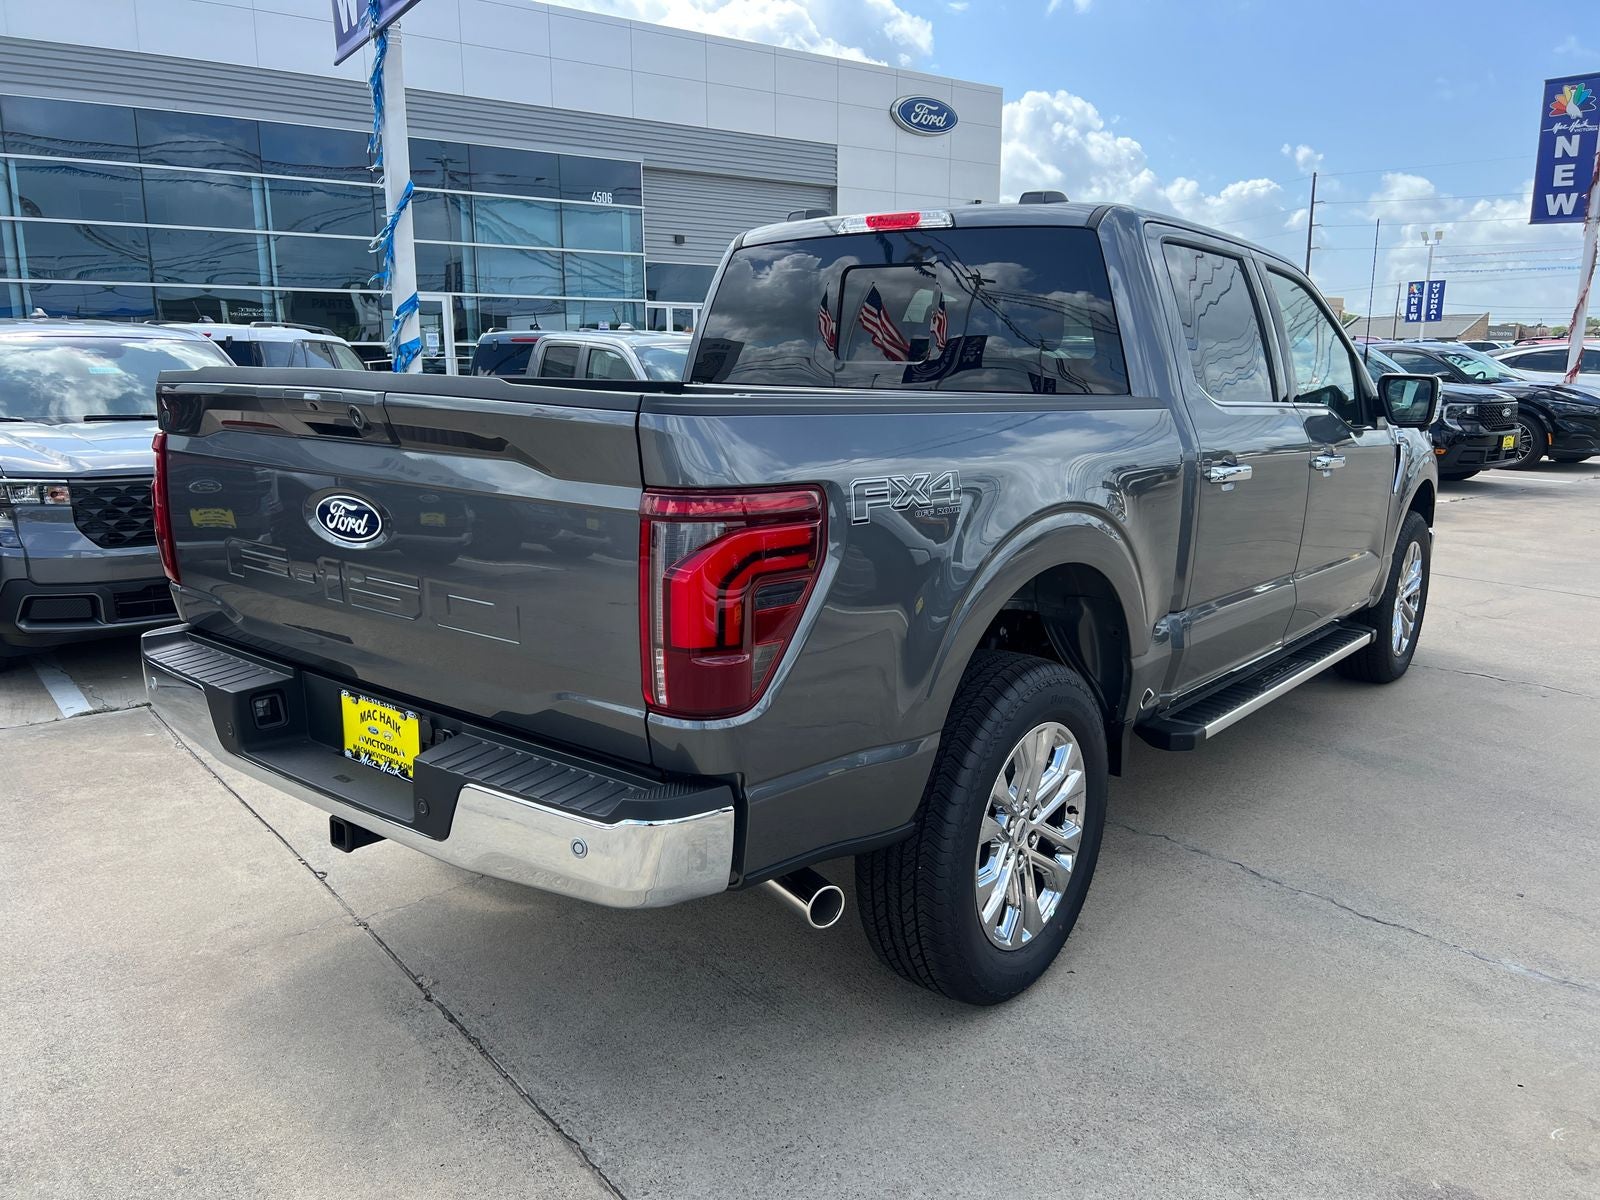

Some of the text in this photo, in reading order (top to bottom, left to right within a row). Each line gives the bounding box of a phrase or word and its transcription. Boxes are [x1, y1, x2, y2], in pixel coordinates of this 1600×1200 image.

[910, 102, 948, 127] Ford
[1545, 135, 1580, 216] NEW
[591, 191, 613, 204] 4506
[1408, 298, 1418, 321] NEW
[1430, 283, 1440, 320] HYUNDAI
[849, 469, 962, 526] FX4
[326, 500, 369, 535] Ford
[914, 508, 935, 518] OFF
[360, 709, 378, 724] MAC
[379, 710, 402, 737] HAIK
[363, 736, 400, 756] VICTORIA
[359, 752, 404, 778] Mac Haik
